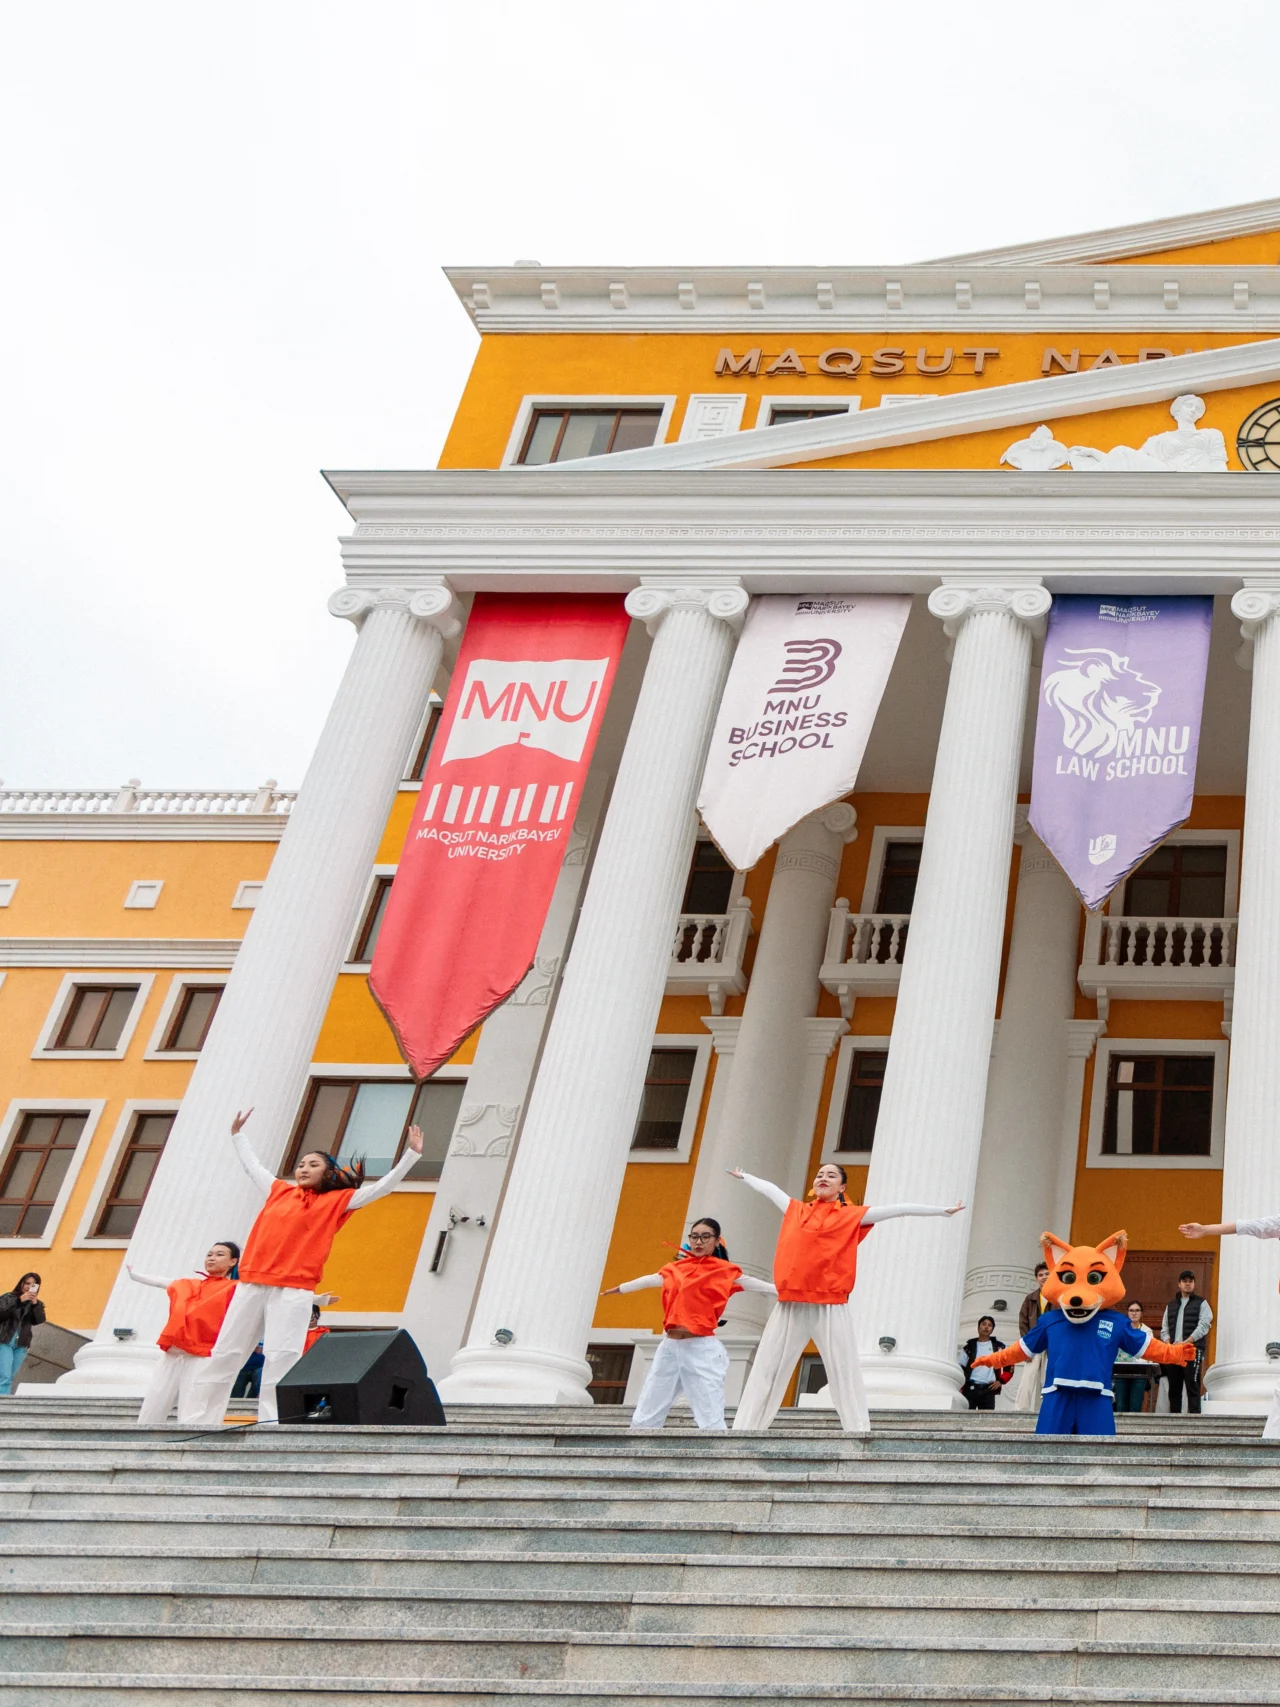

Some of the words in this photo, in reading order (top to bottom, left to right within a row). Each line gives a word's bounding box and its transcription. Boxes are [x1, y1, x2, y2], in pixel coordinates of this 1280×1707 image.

[714, 347, 999, 378] MAQSUT
[461, 680, 598, 722] MNU
[763, 694, 821, 715] MNU
[728, 711, 848, 744] BUSINESS
[1115, 726, 1190, 758] MNU
[728, 732, 834, 767] SCHOOL
[1056, 755, 1099, 781] LAW
[1105, 755, 1187, 781] SCHOOL
[416, 828, 474, 845] MAQSUT
[476, 828, 562, 845] NARIKBAYEV
[448, 844, 526, 860] UNIVERSITY
